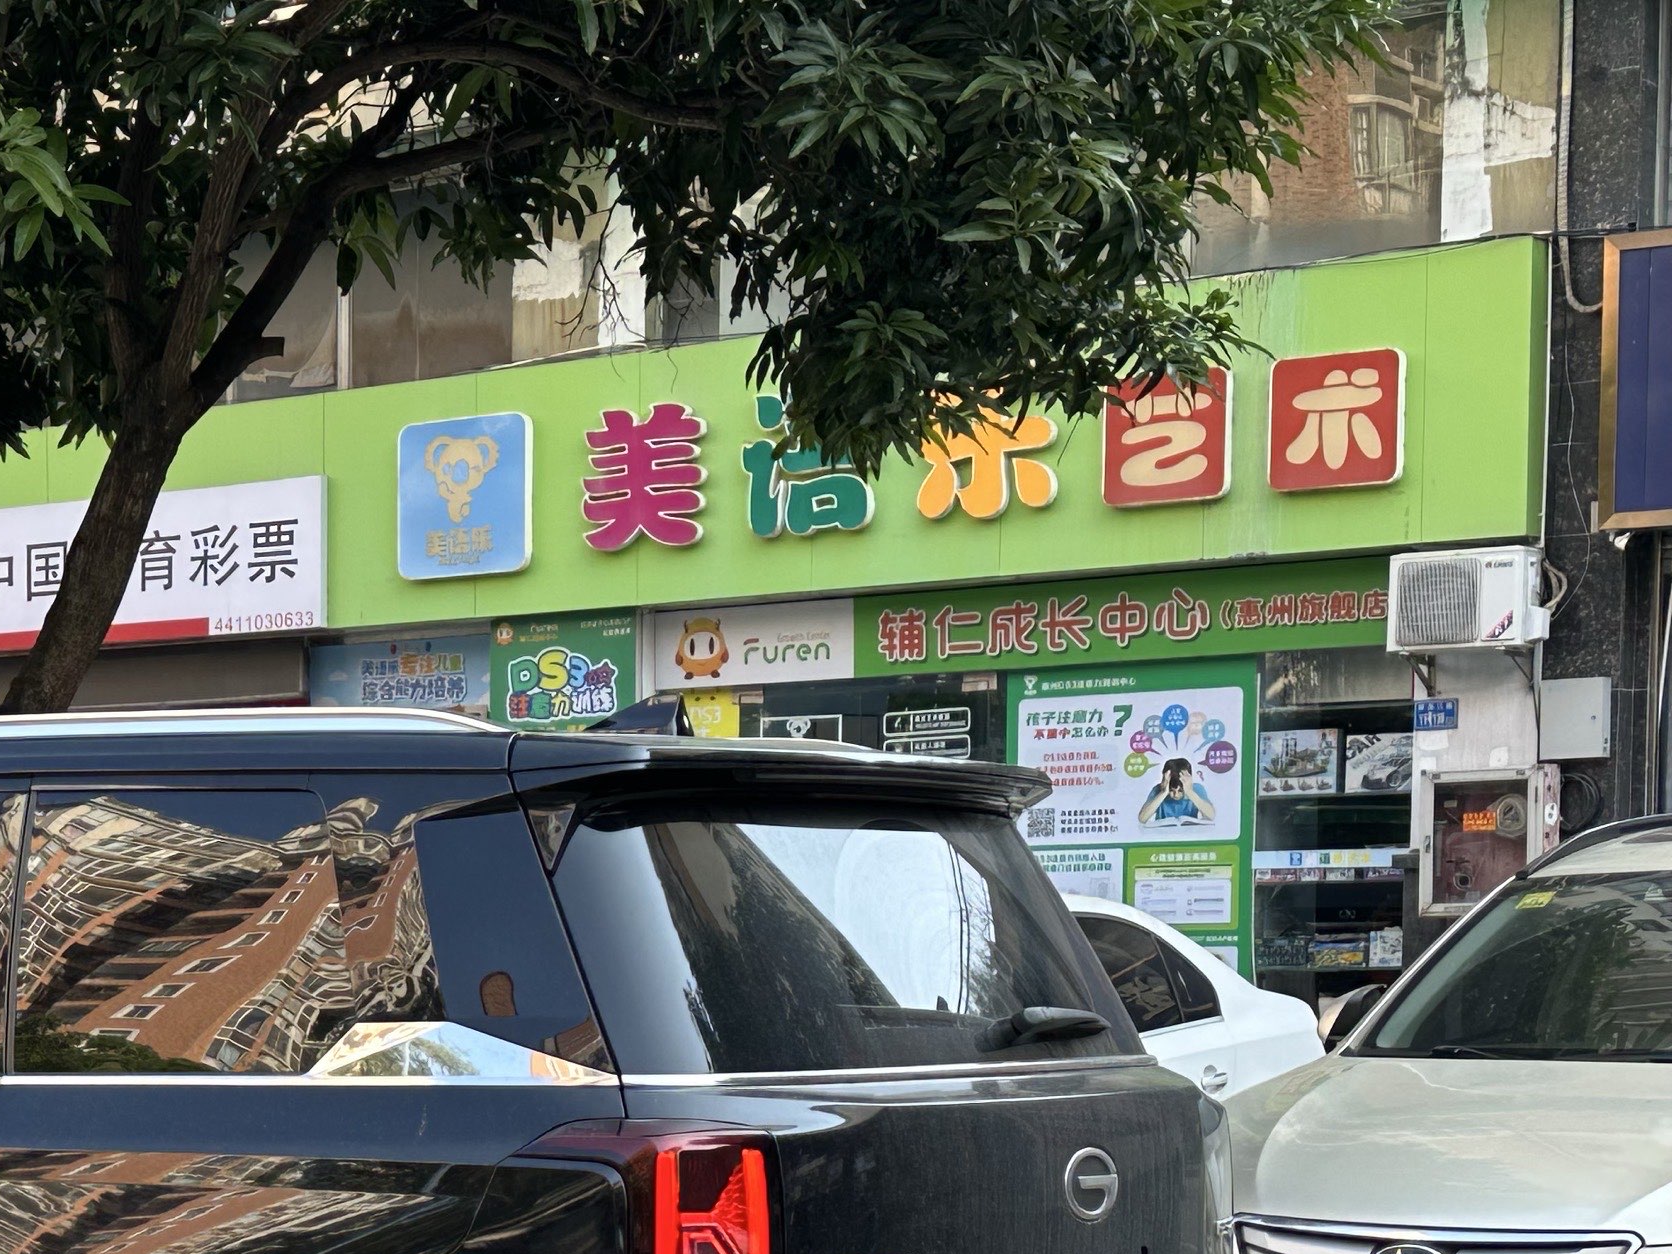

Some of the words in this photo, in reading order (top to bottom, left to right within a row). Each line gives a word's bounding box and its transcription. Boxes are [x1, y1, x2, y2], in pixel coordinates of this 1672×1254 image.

[214, 611, 315, 632] 4411030633
[877, 587, 1211, 662] 辅仁成长中心
